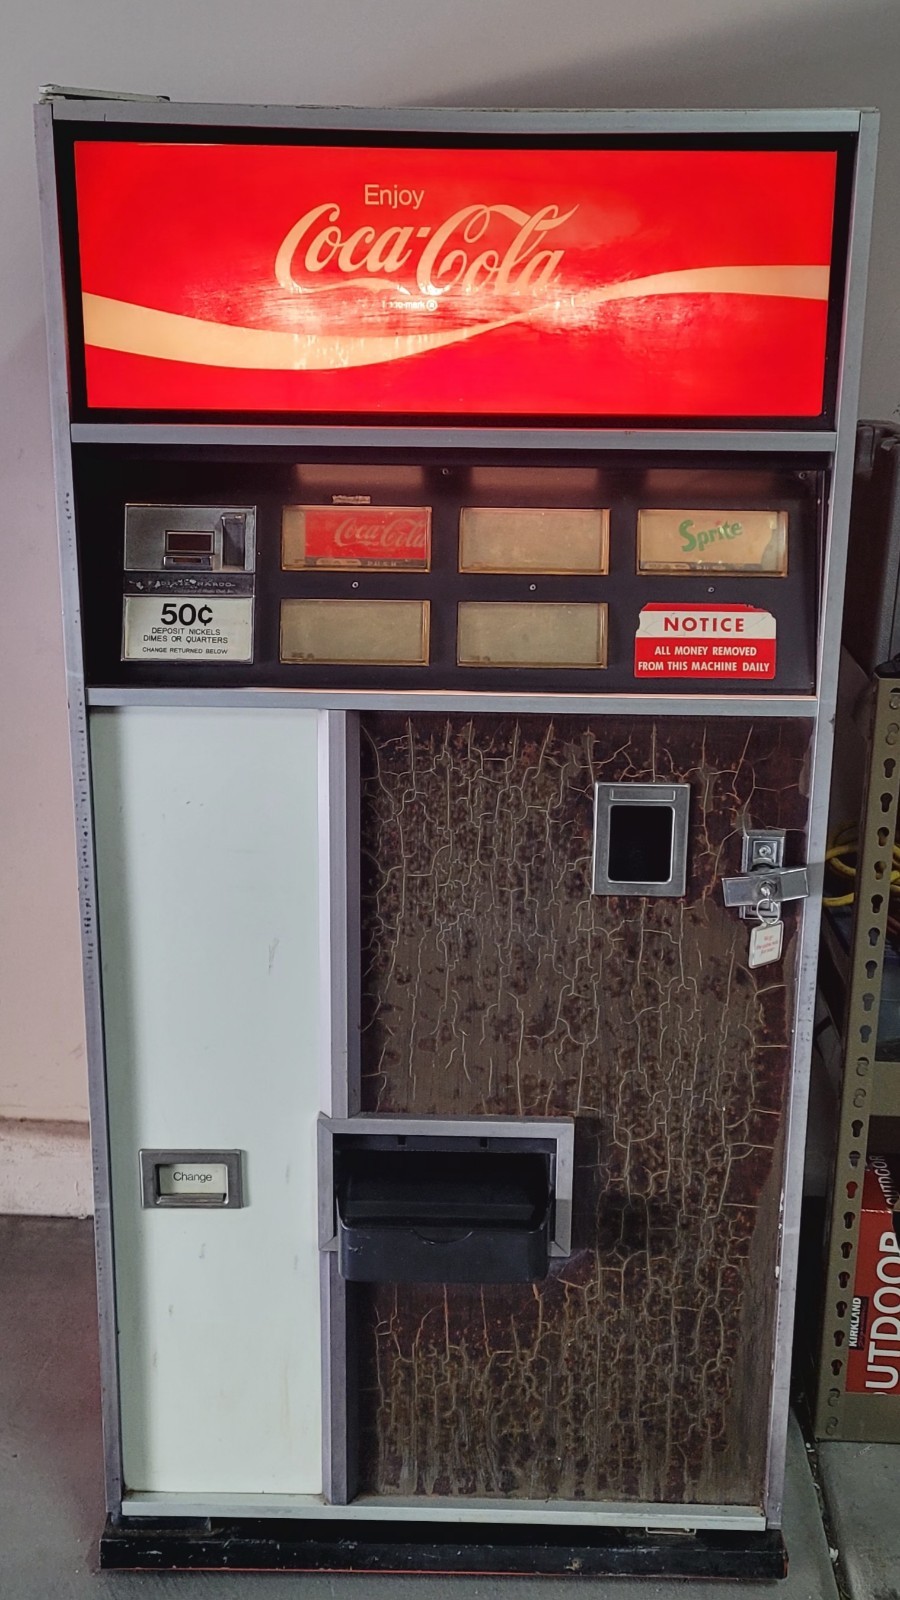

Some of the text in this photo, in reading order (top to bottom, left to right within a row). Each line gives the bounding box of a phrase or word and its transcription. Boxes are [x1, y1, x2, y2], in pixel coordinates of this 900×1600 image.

[364, 184, 425, 210] Enjoy
[274, 203, 580, 296] Coca-Cola
[334, 517, 426, 549] Coca-Cola
[678, 519, 743, 552] Sprite
[160, 603, 213, 627] 50¢
[663, 616, 745, 633] NOTICE
[151, 627, 221, 636] DEPOSIT NICKELS
[171, 635, 182, 643] OR
[185, 636, 229, 644] QUARTERS
[654, 646, 757, 657] ALL MONEY REMOVED
[638, 661, 770, 672] FROM THIS MACHINE DAILY
[173, 1171, 213, 1183] Change
[848, 1297, 862, 1348] KIRKLAND
[865, 1231, 900, 1395] UTDOOR
